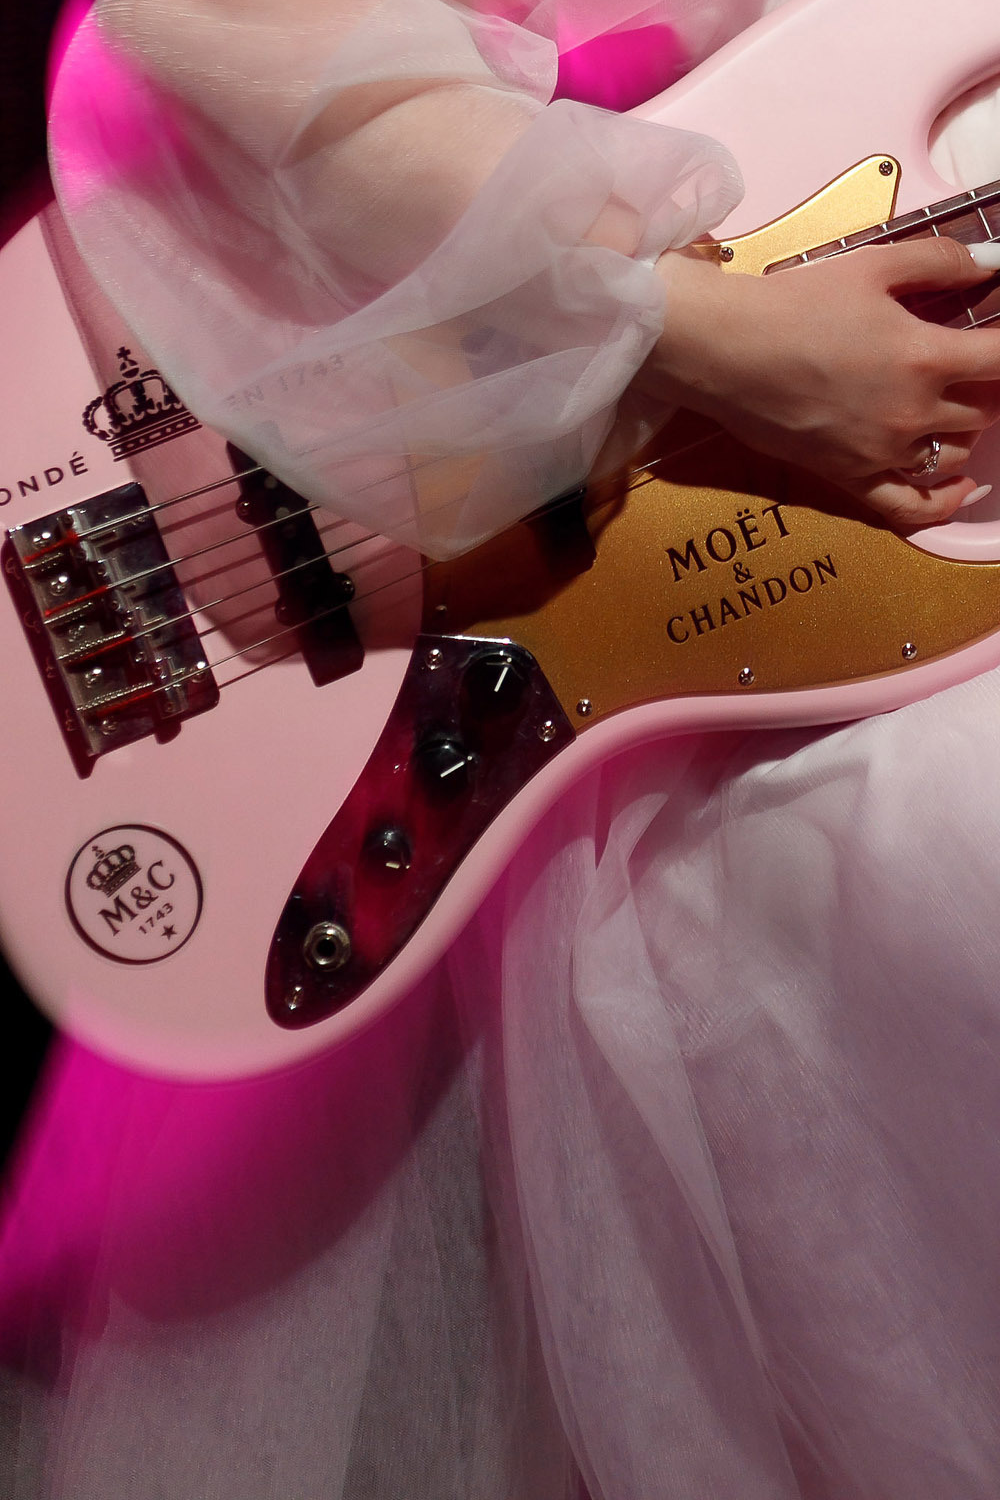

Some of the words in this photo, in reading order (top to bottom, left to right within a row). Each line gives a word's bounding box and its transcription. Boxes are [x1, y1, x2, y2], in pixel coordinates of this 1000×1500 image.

[664, 502, 791, 583] MOËT
[732, 561, 755, 584] &
[666, 554, 839, 644] CHANDON
[97, 859, 176, 937] M&C
[138, 902, 174, 935] 1743
